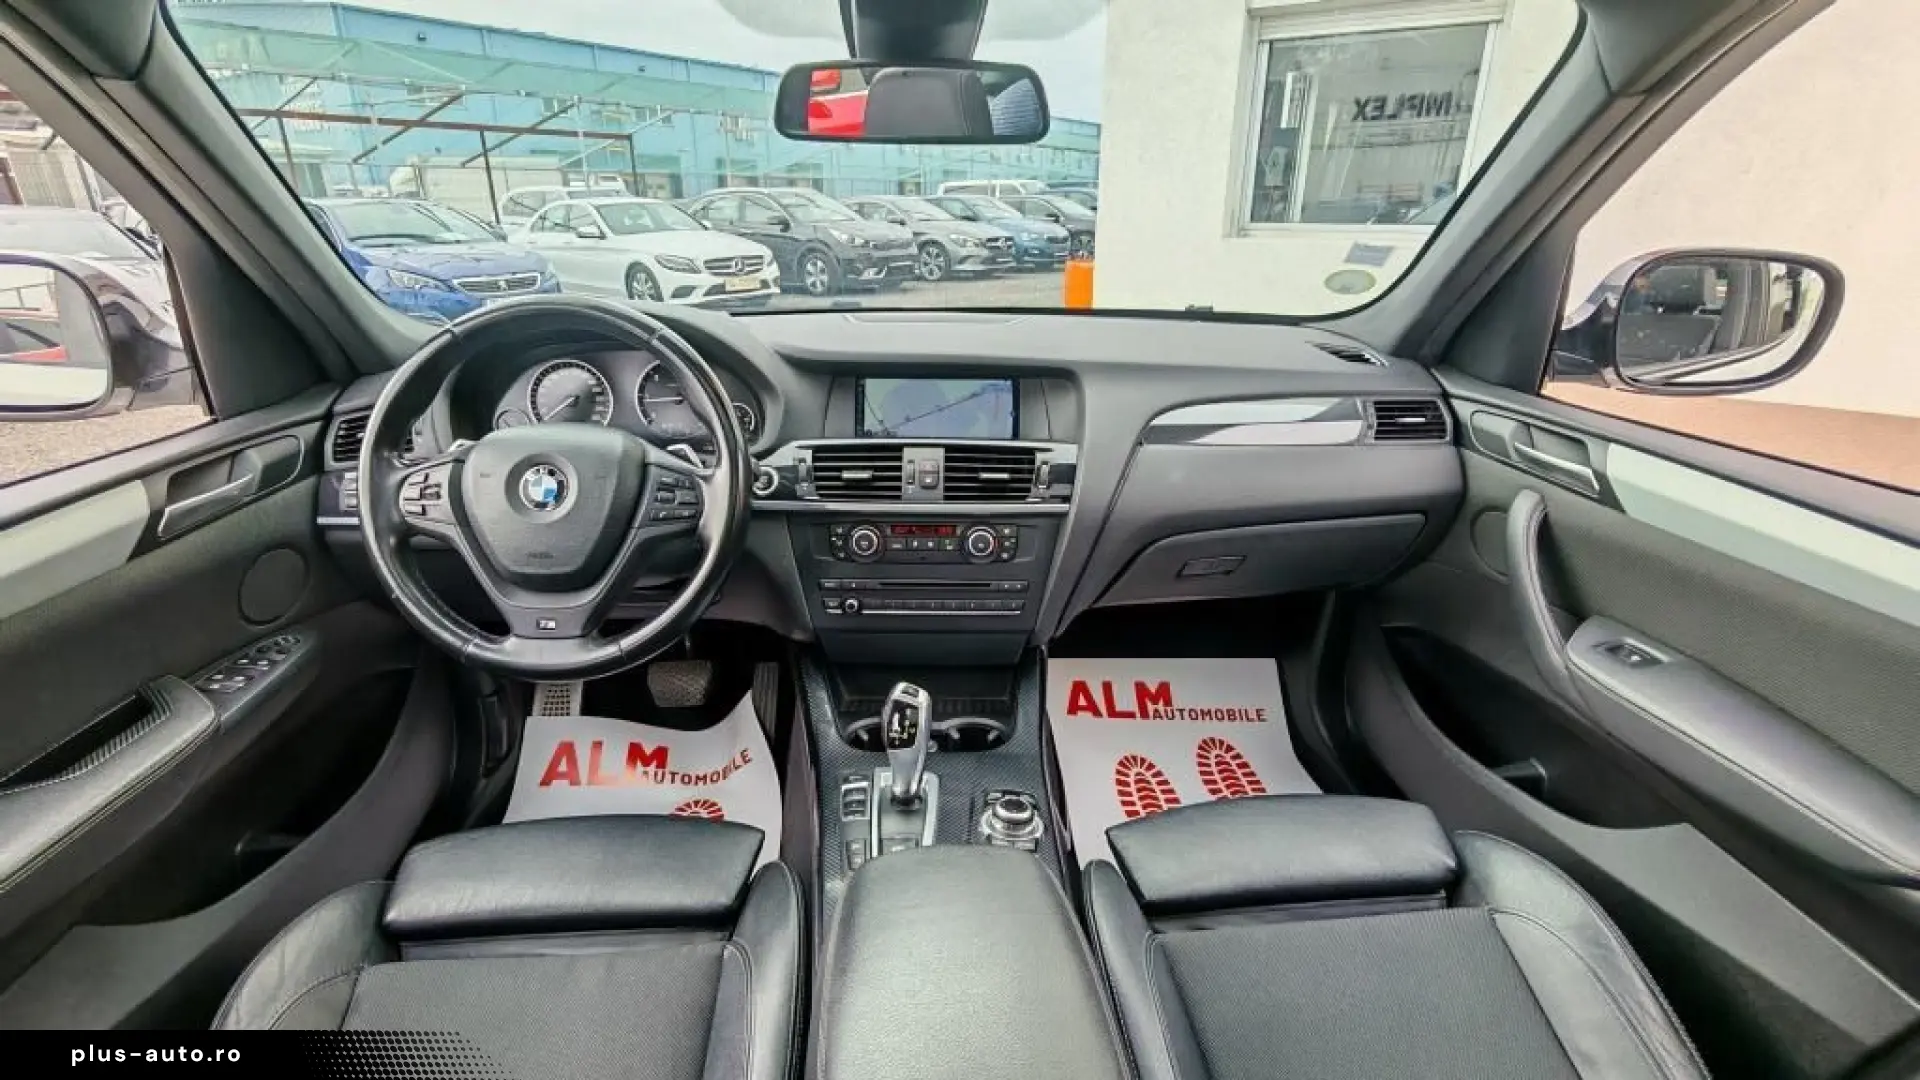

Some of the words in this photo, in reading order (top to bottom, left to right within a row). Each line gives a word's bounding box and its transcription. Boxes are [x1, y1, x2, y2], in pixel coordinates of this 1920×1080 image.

[1066, 680, 1173, 720] ALM
[1152, 708, 1268, 722] AUTOMOBILE
[539, 740, 670, 787] ALM
